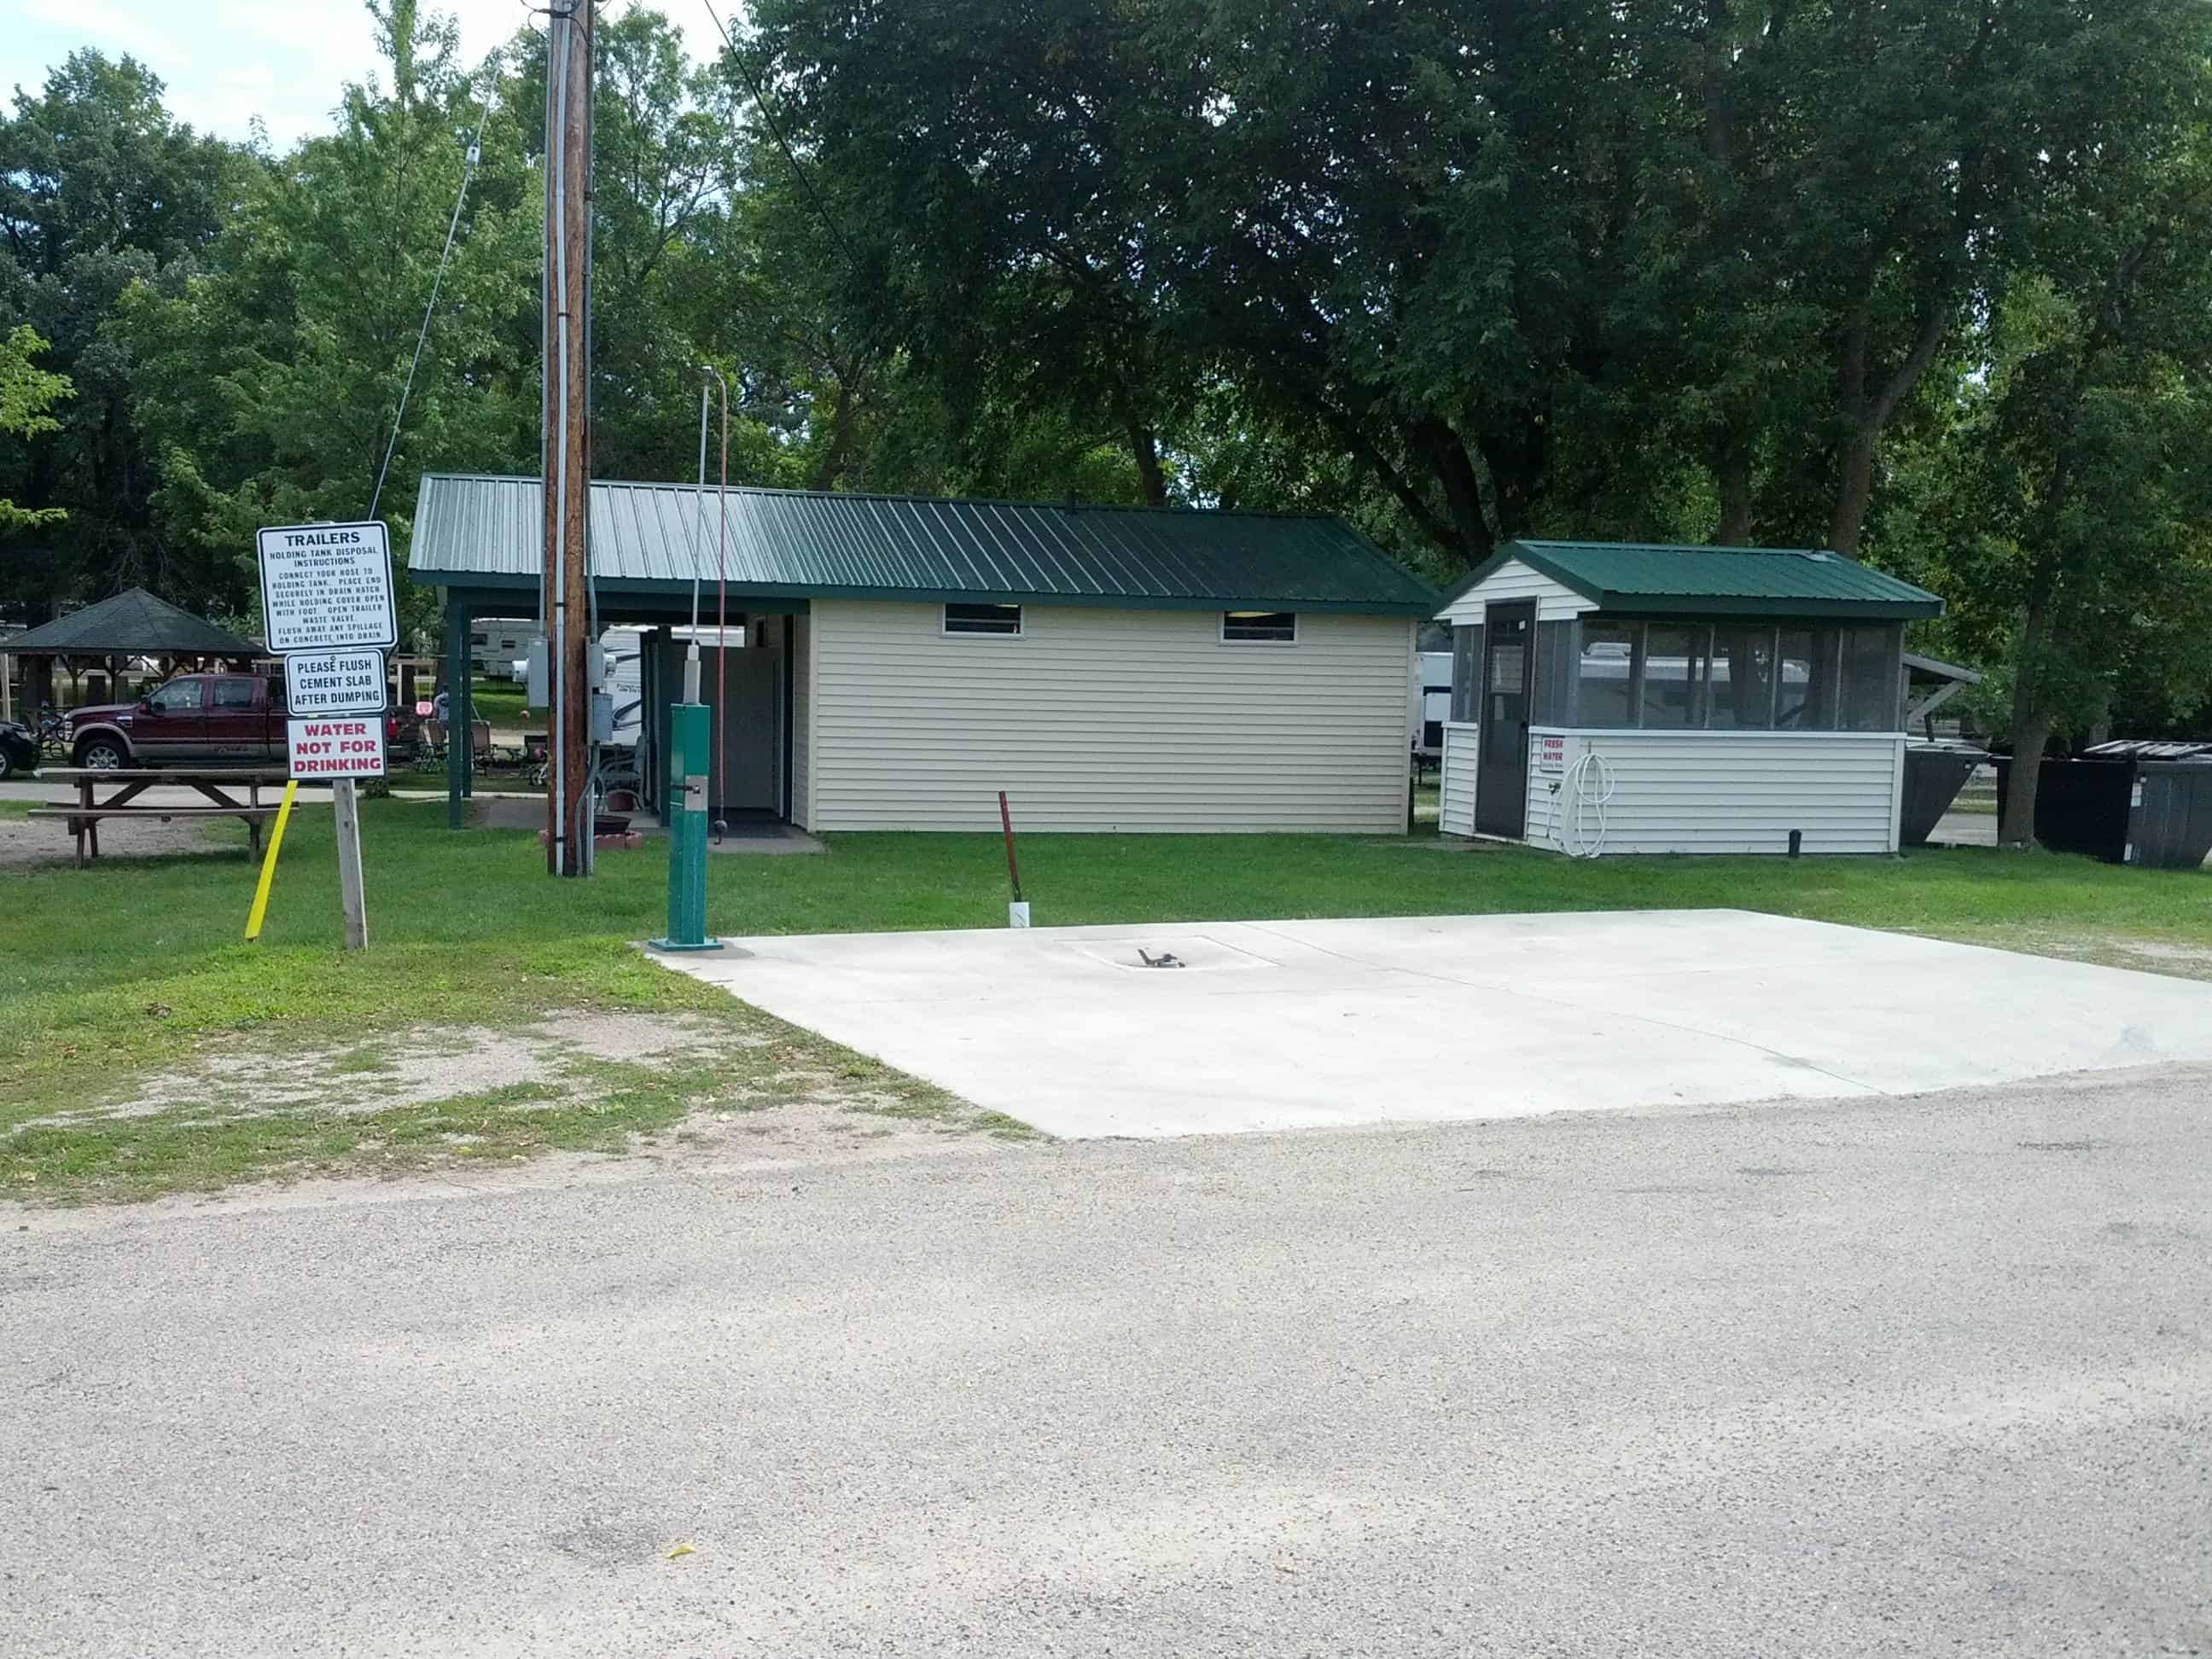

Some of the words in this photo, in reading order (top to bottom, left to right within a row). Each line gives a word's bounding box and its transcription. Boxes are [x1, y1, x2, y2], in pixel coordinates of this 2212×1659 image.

[285, 532, 360, 546] TRAILERS
[270, 550, 307, 560] HOLDING
[310, 549, 332, 557] TANK
[335, 546, 377, 556] DISPOSAL
[294, 556, 355, 568] INSTRUCTIONS
[278, 571, 313, 579] CONNECT
[272, 580, 306, 589] HOLDING
[276, 588, 313, 598] SECURELY
[329, 587, 352, 596] DRAIN
[355, 585, 380, 594] HATCH
[300, 597, 333, 606] HOLDING
[303, 615, 327, 624] WASTE
[329, 624, 343, 632] ANY
[347, 621, 382, 632] SPILLAGE
[294, 634, 332, 643] CONCRETE
[297, 661, 335, 673] PLEASE
[340, 660, 371, 672] FLUSH
[300, 677, 342, 690] CEMENT
[346, 675, 372, 687] SLAB
[294, 693, 328, 705] AFTER
[330, 690, 380, 703] DUMPING
[305, 723, 367, 736] WATER
[296, 742, 332, 754] NOT
[340, 740, 376, 754] FOR
[1544, 739, 1563, 748] FRESH
[1543, 752, 1563, 760] WATER
[294, 757, 381, 772] DRINKING
